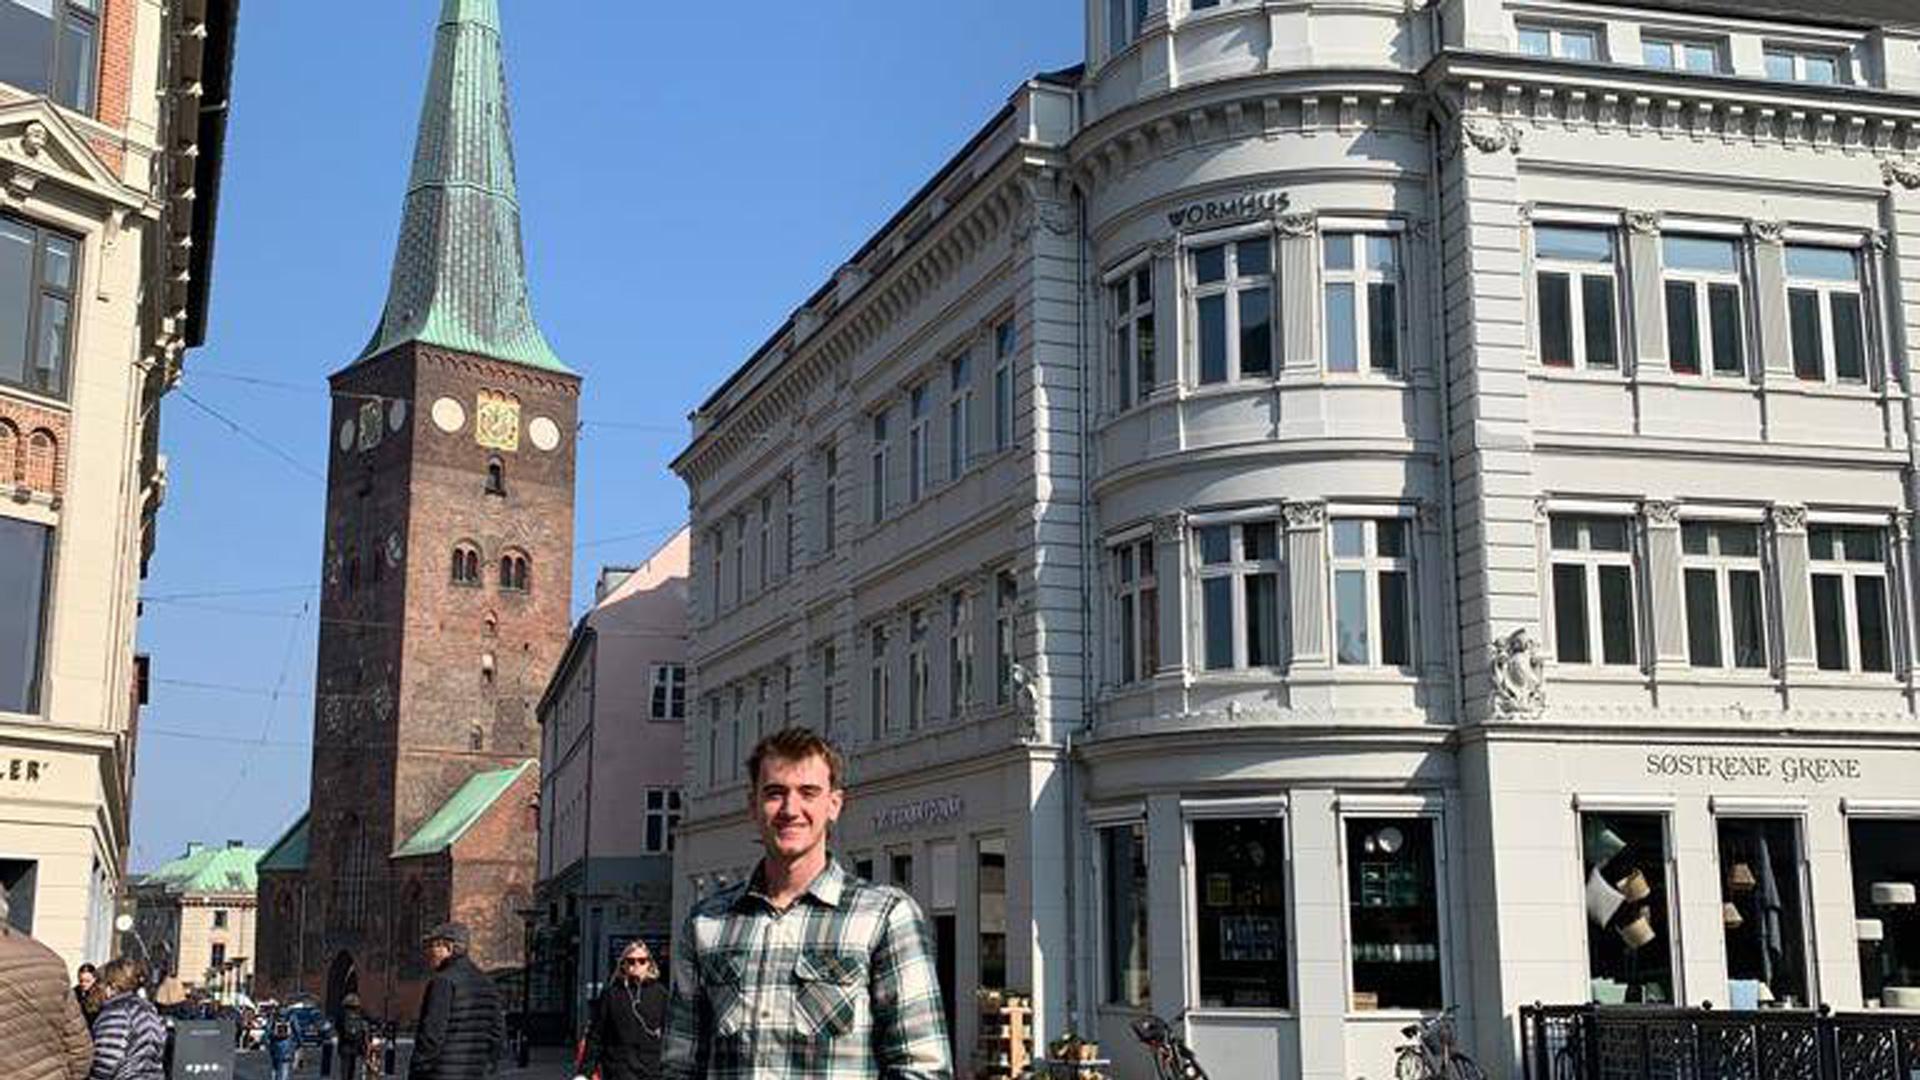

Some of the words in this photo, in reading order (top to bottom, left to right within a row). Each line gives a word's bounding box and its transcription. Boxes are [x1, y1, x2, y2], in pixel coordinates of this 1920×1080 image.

[1168, 191, 1290, 227] WORMHUS
[1646, 754, 1771, 781] SØSTRENE
[1781, 757, 1861, 783] GRENE
